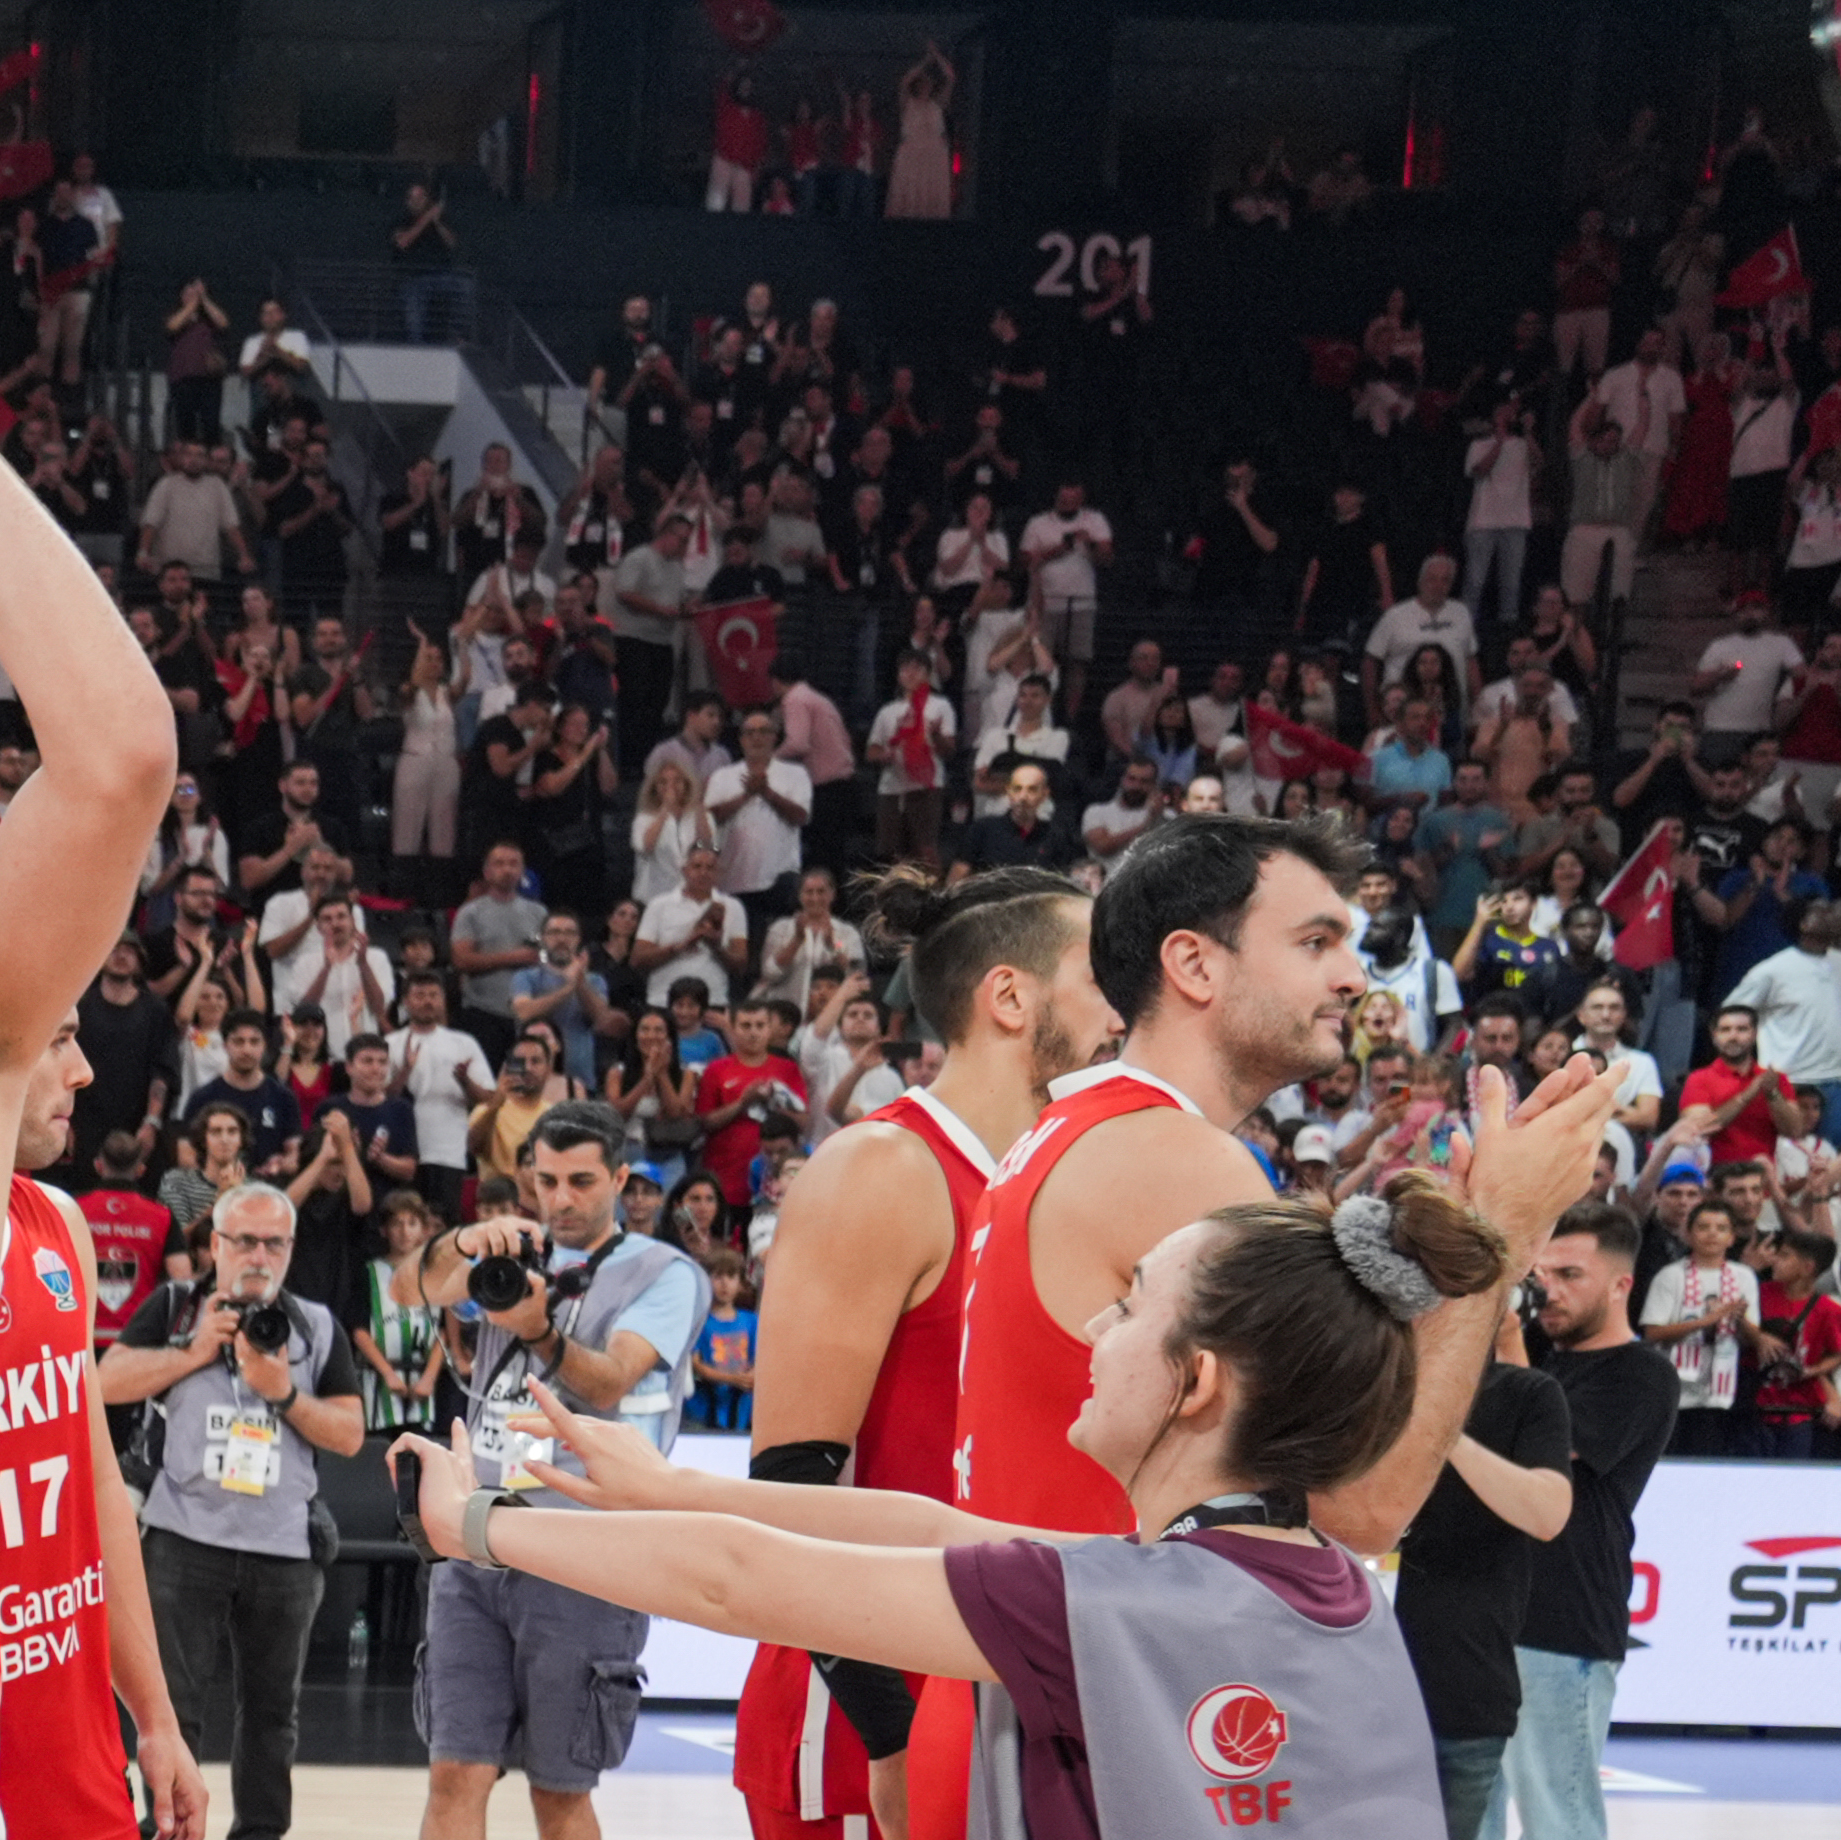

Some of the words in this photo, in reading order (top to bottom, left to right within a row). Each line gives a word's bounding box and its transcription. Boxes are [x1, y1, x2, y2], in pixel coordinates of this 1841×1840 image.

[1035, 232, 1151, 298] 201
[0, 1621, 80, 1683] BBVA
[1205, 1780, 1292, 1826] TBF
